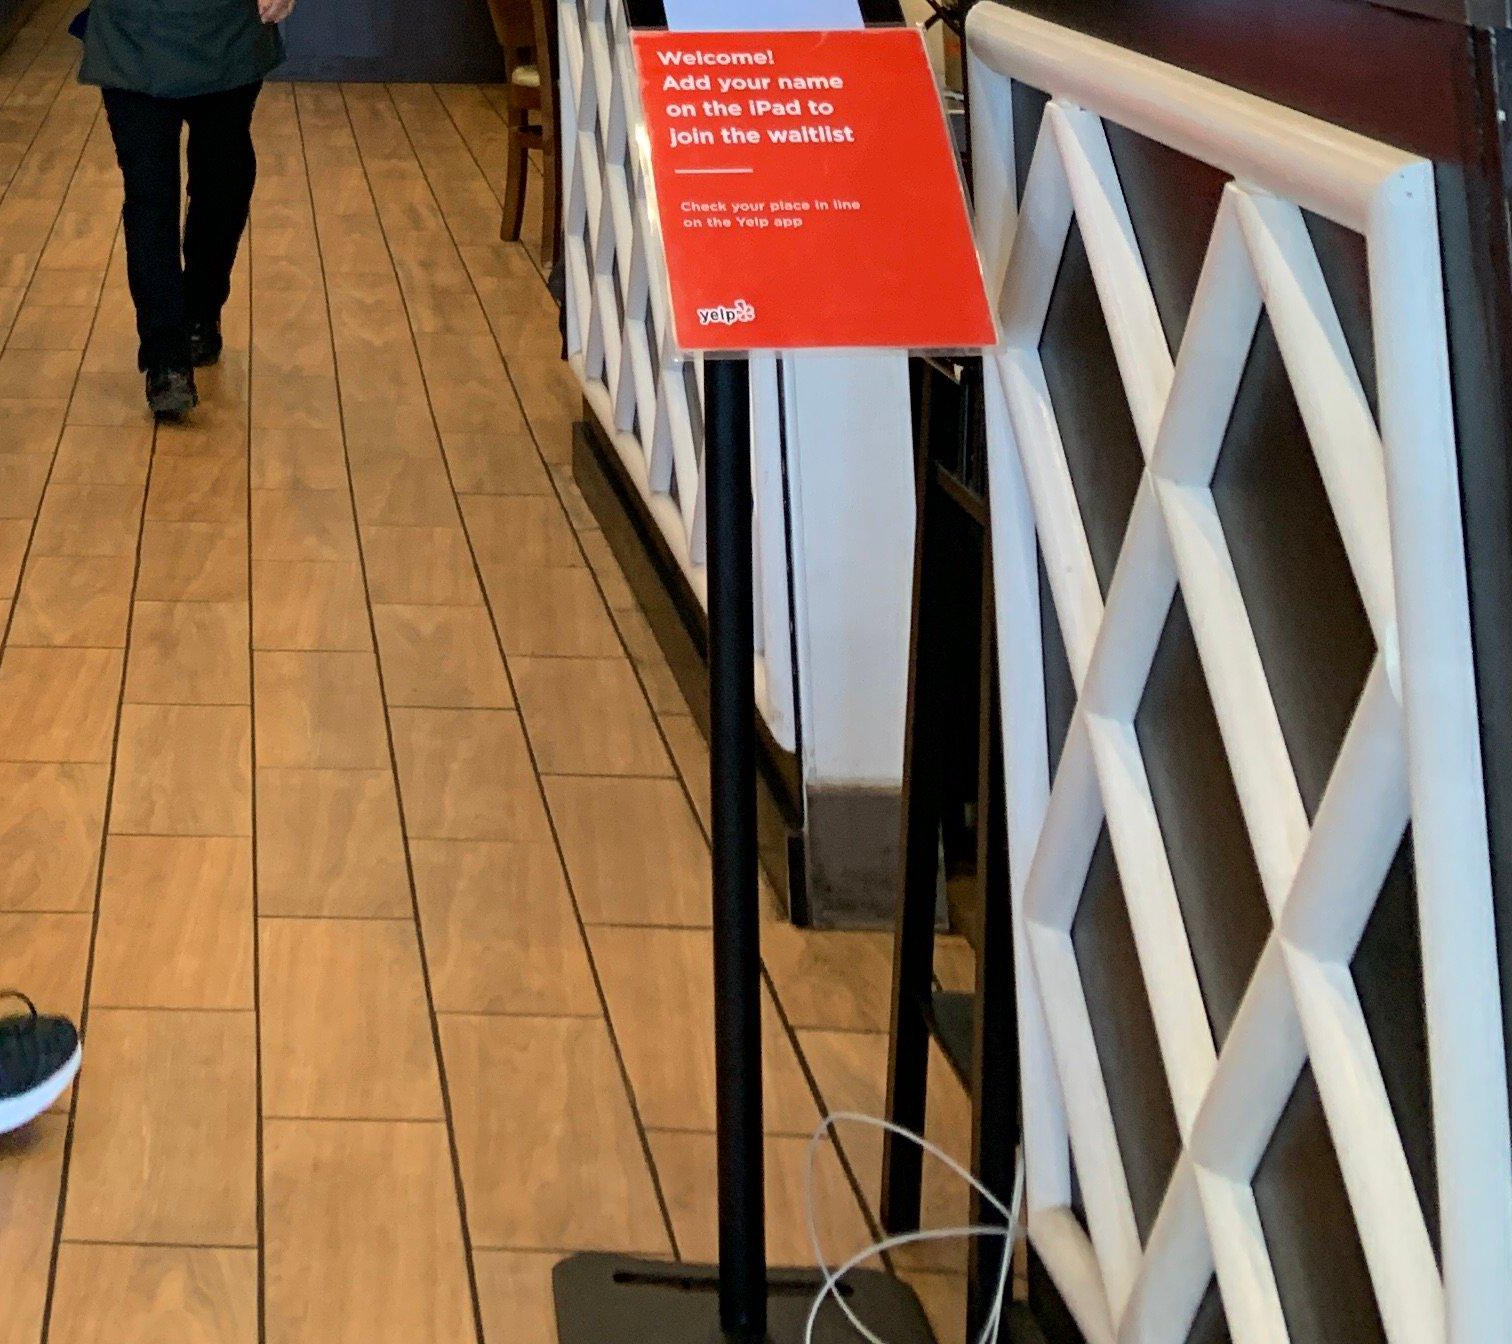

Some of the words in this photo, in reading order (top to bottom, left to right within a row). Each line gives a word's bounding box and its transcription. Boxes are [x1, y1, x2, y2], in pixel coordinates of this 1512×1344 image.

[656, 49, 775, 66] Welcome!
[662, 74, 711, 91] Add
[717, 76, 771, 93] your
[778, 75, 844, 90] name
[666, 103, 696, 117] on
[702, 99, 742, 117] the
[748, 99, 801, 117] iPad
[807, 100, 834, 116] to
[669, 126, 714, 148] join
[720, 126, 760, 144] the
[766, 125, 855, 144] waitlist
[680, 200, 727, 213] Check
[731, 201, 765, 213] your
[769, 199, 811, 213] place
[814, 198, 829, 210] in
[832, 198, 861, 210] line
[683, 217, 703, 228] on
[706, 216, 732, 228] the
[735, 216, 769, 229] Yelp
[773, 217, 803, 229] app
[697, 307, 736, 324] yelp
